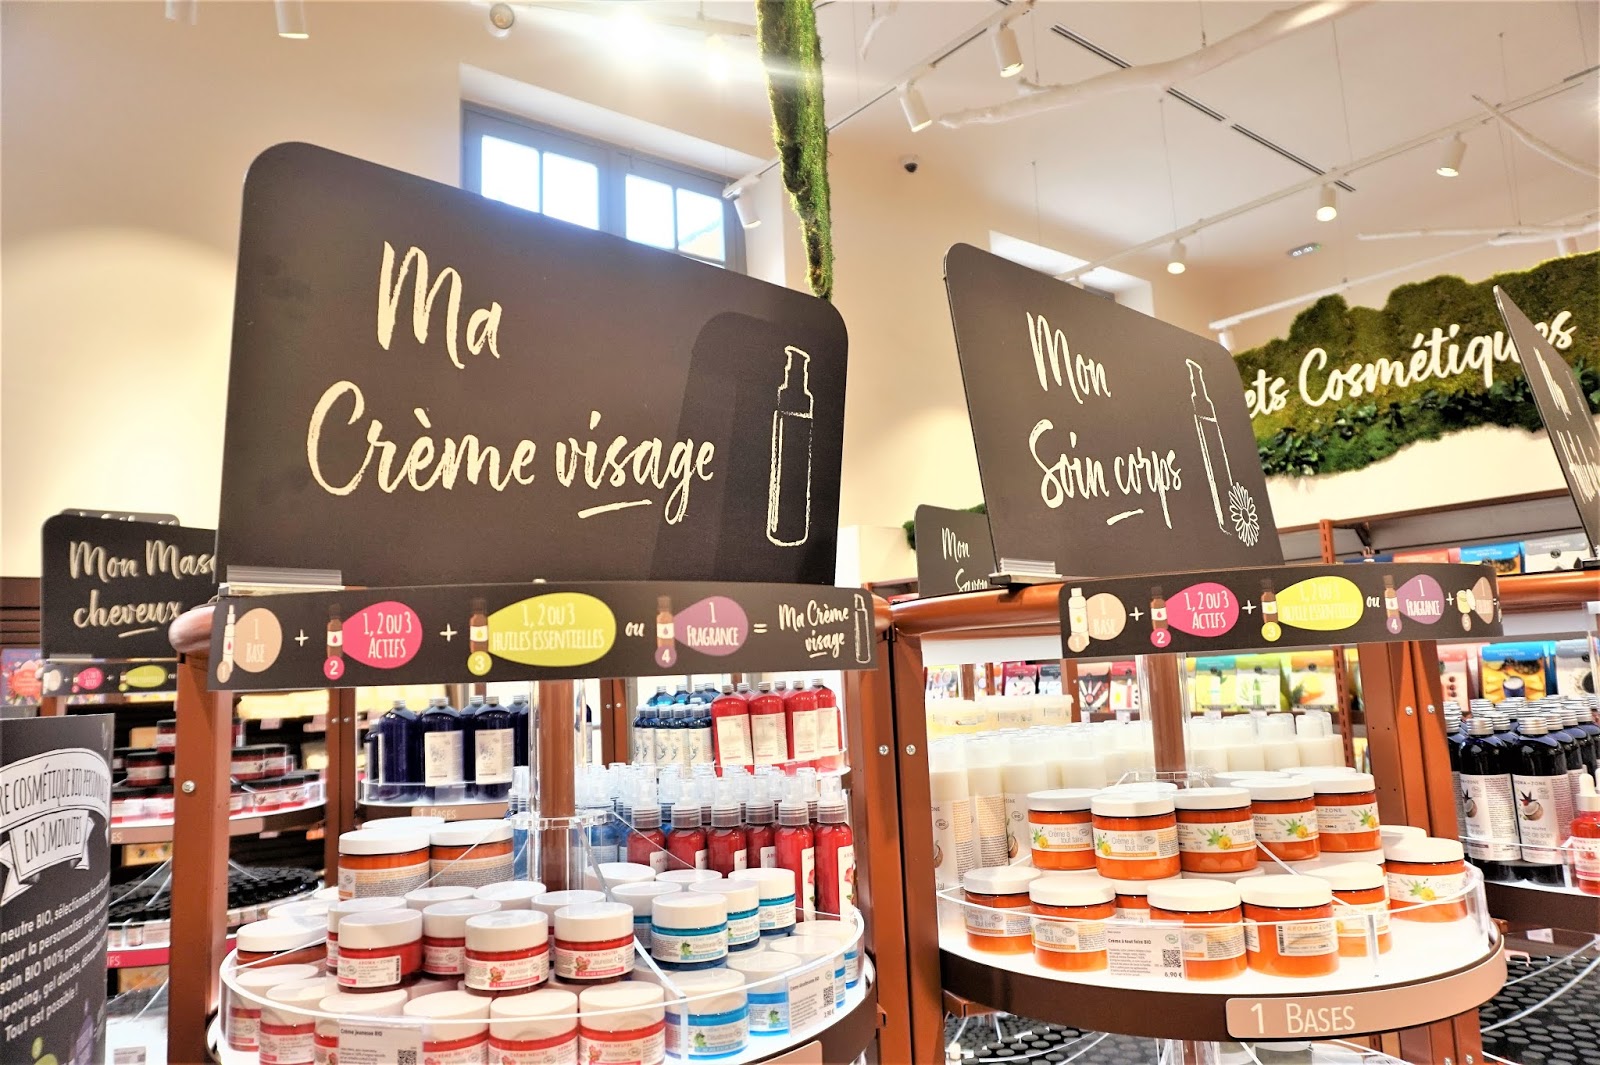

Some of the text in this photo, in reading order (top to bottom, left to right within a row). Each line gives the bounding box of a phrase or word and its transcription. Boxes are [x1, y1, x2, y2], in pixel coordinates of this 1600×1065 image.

[377, 240, 503, 370] Ma
[1026, 312, 1112, 405] Mon
[306, 379, 715, 525] Crème visage
[1029, 418, 1182, 530] Soin corps
[942, 527, 971, 563] Mon
[69, 539, 215, 583] Mon Mas
[1366, 595, 1381, 608] ou
[1417, 579, 1425, 597] 1
[72, 588, 183, 629] cheveux
[708, 601, 717, 623] 1
[778, 598, 850, 632] Ma Crème
[1191, 611, 1227, 630] ACTIFS
[1405, 599, 1442, 617] FRAGRANCE
[624, 621, 646, 638] ou
[686, 625, 740, 648] FRAGRANCE
[1155, 631, 1165, 644] 2
[1391, 618, 1398, 630] 4
[367, 636, 407, 660] ACTIFS
[661, 648, 671, 663] 4
[804, 630, 846, 658] visage
[329, 659, 338, 676] 2
[474, 655, 484, 671] 3
[13, 763, 70, 811] COSMÉTIQUE
[24, 828, 39, 864] EN
[41, 821, 46, 854] 3
[0, 920, 34, 944] neutre
[36, 908, 54, 930] BIO,
[0, 947, 26, 973] pour
[28, 941, 37, 957] la
[38, 918, 84, 955] personnaliser
[0, 975, 22, 995] soin
[25, 961, 42, 983] BIO
[43, 949, 64, 972] 100%
[43, 976, 57, 999] gel
[5, 1016, 28, 1042] Tout
[30, 1006, 44, 1028] est
[46, 986, 75, 1021] possible
[1250, 1002, 1357, 1034] 1 BASES
